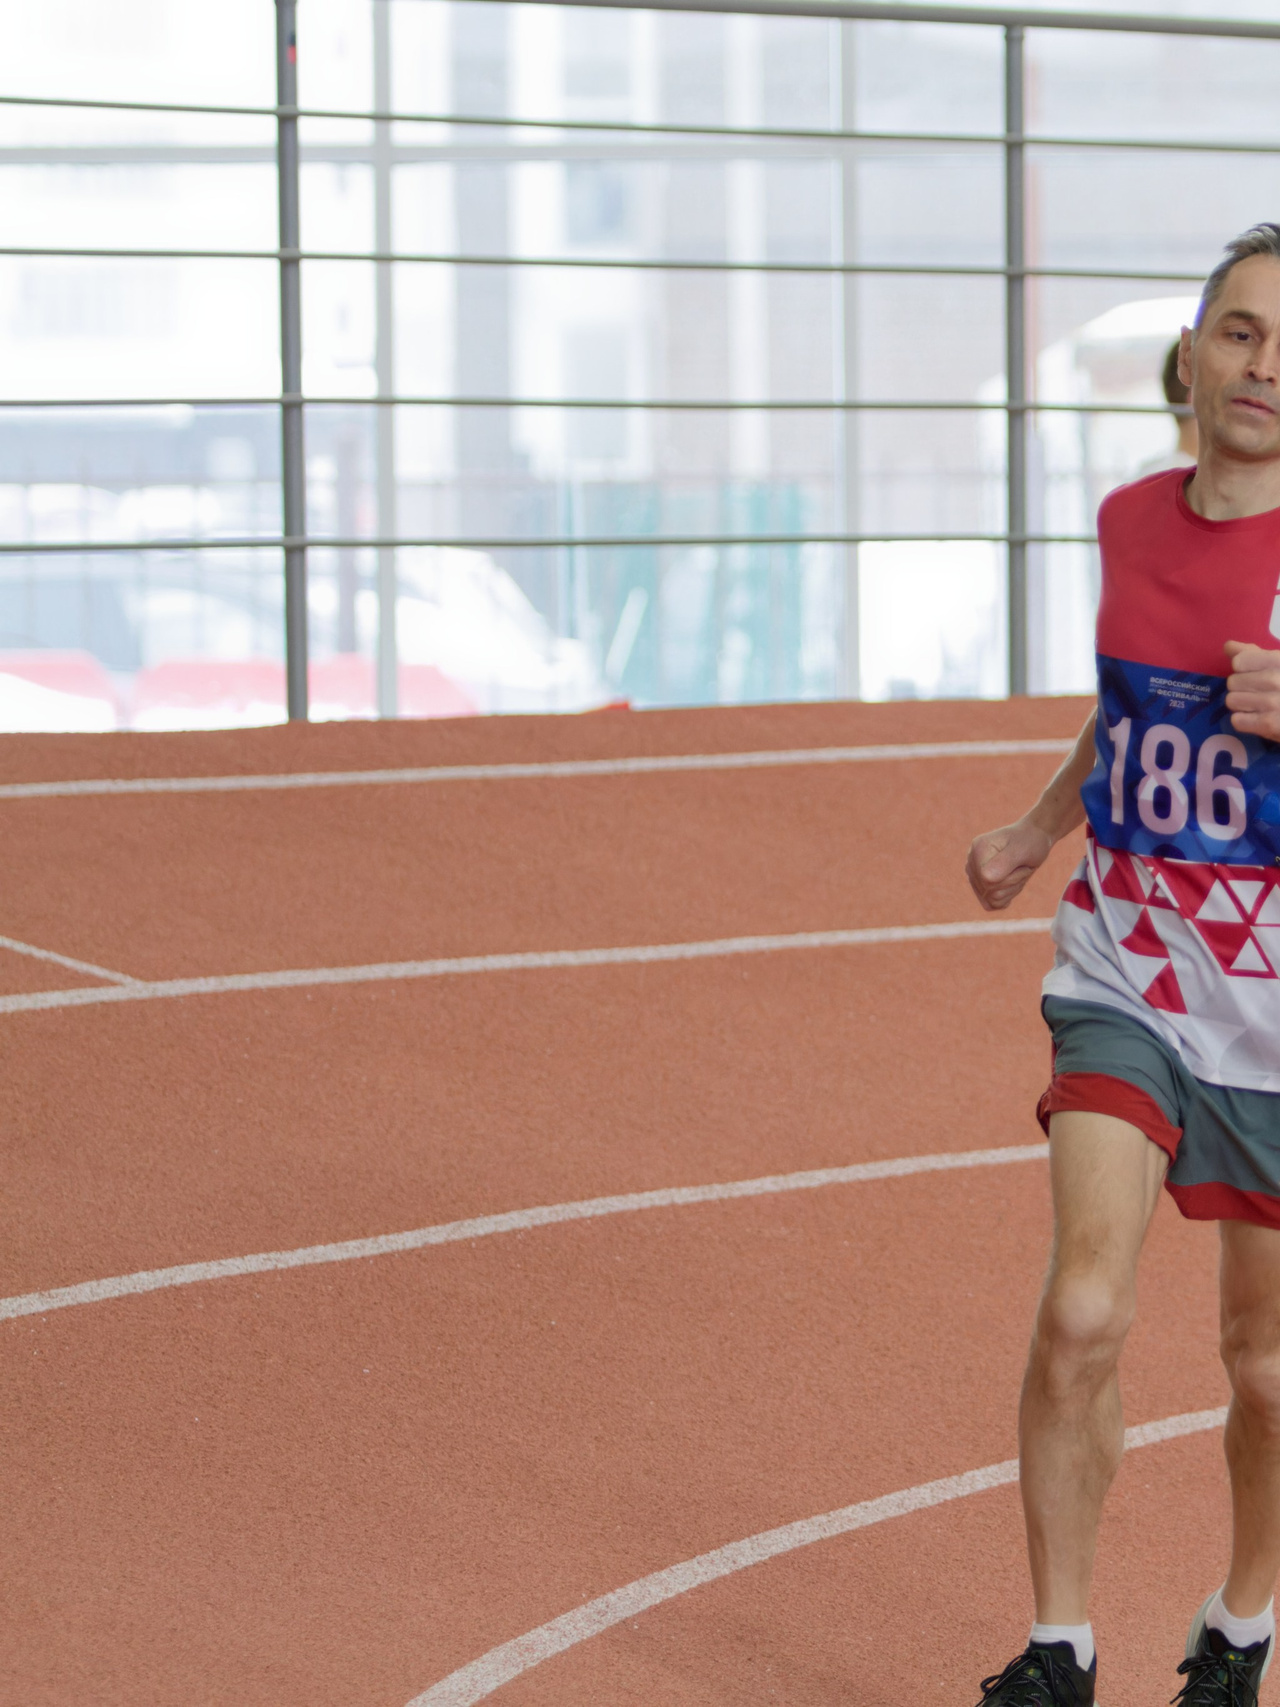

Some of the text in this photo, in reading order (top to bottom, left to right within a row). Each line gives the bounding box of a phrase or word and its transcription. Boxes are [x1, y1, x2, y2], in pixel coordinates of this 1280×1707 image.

[1150, 676, 1210, 692] ВСЕРОССИЙСКИЙ
[1157, 688, 1200, 702] ФЕСТИВАЛЬ
[1169, 699, 1185, 709] 2025
[1109, 716, 1248, 841] 186
